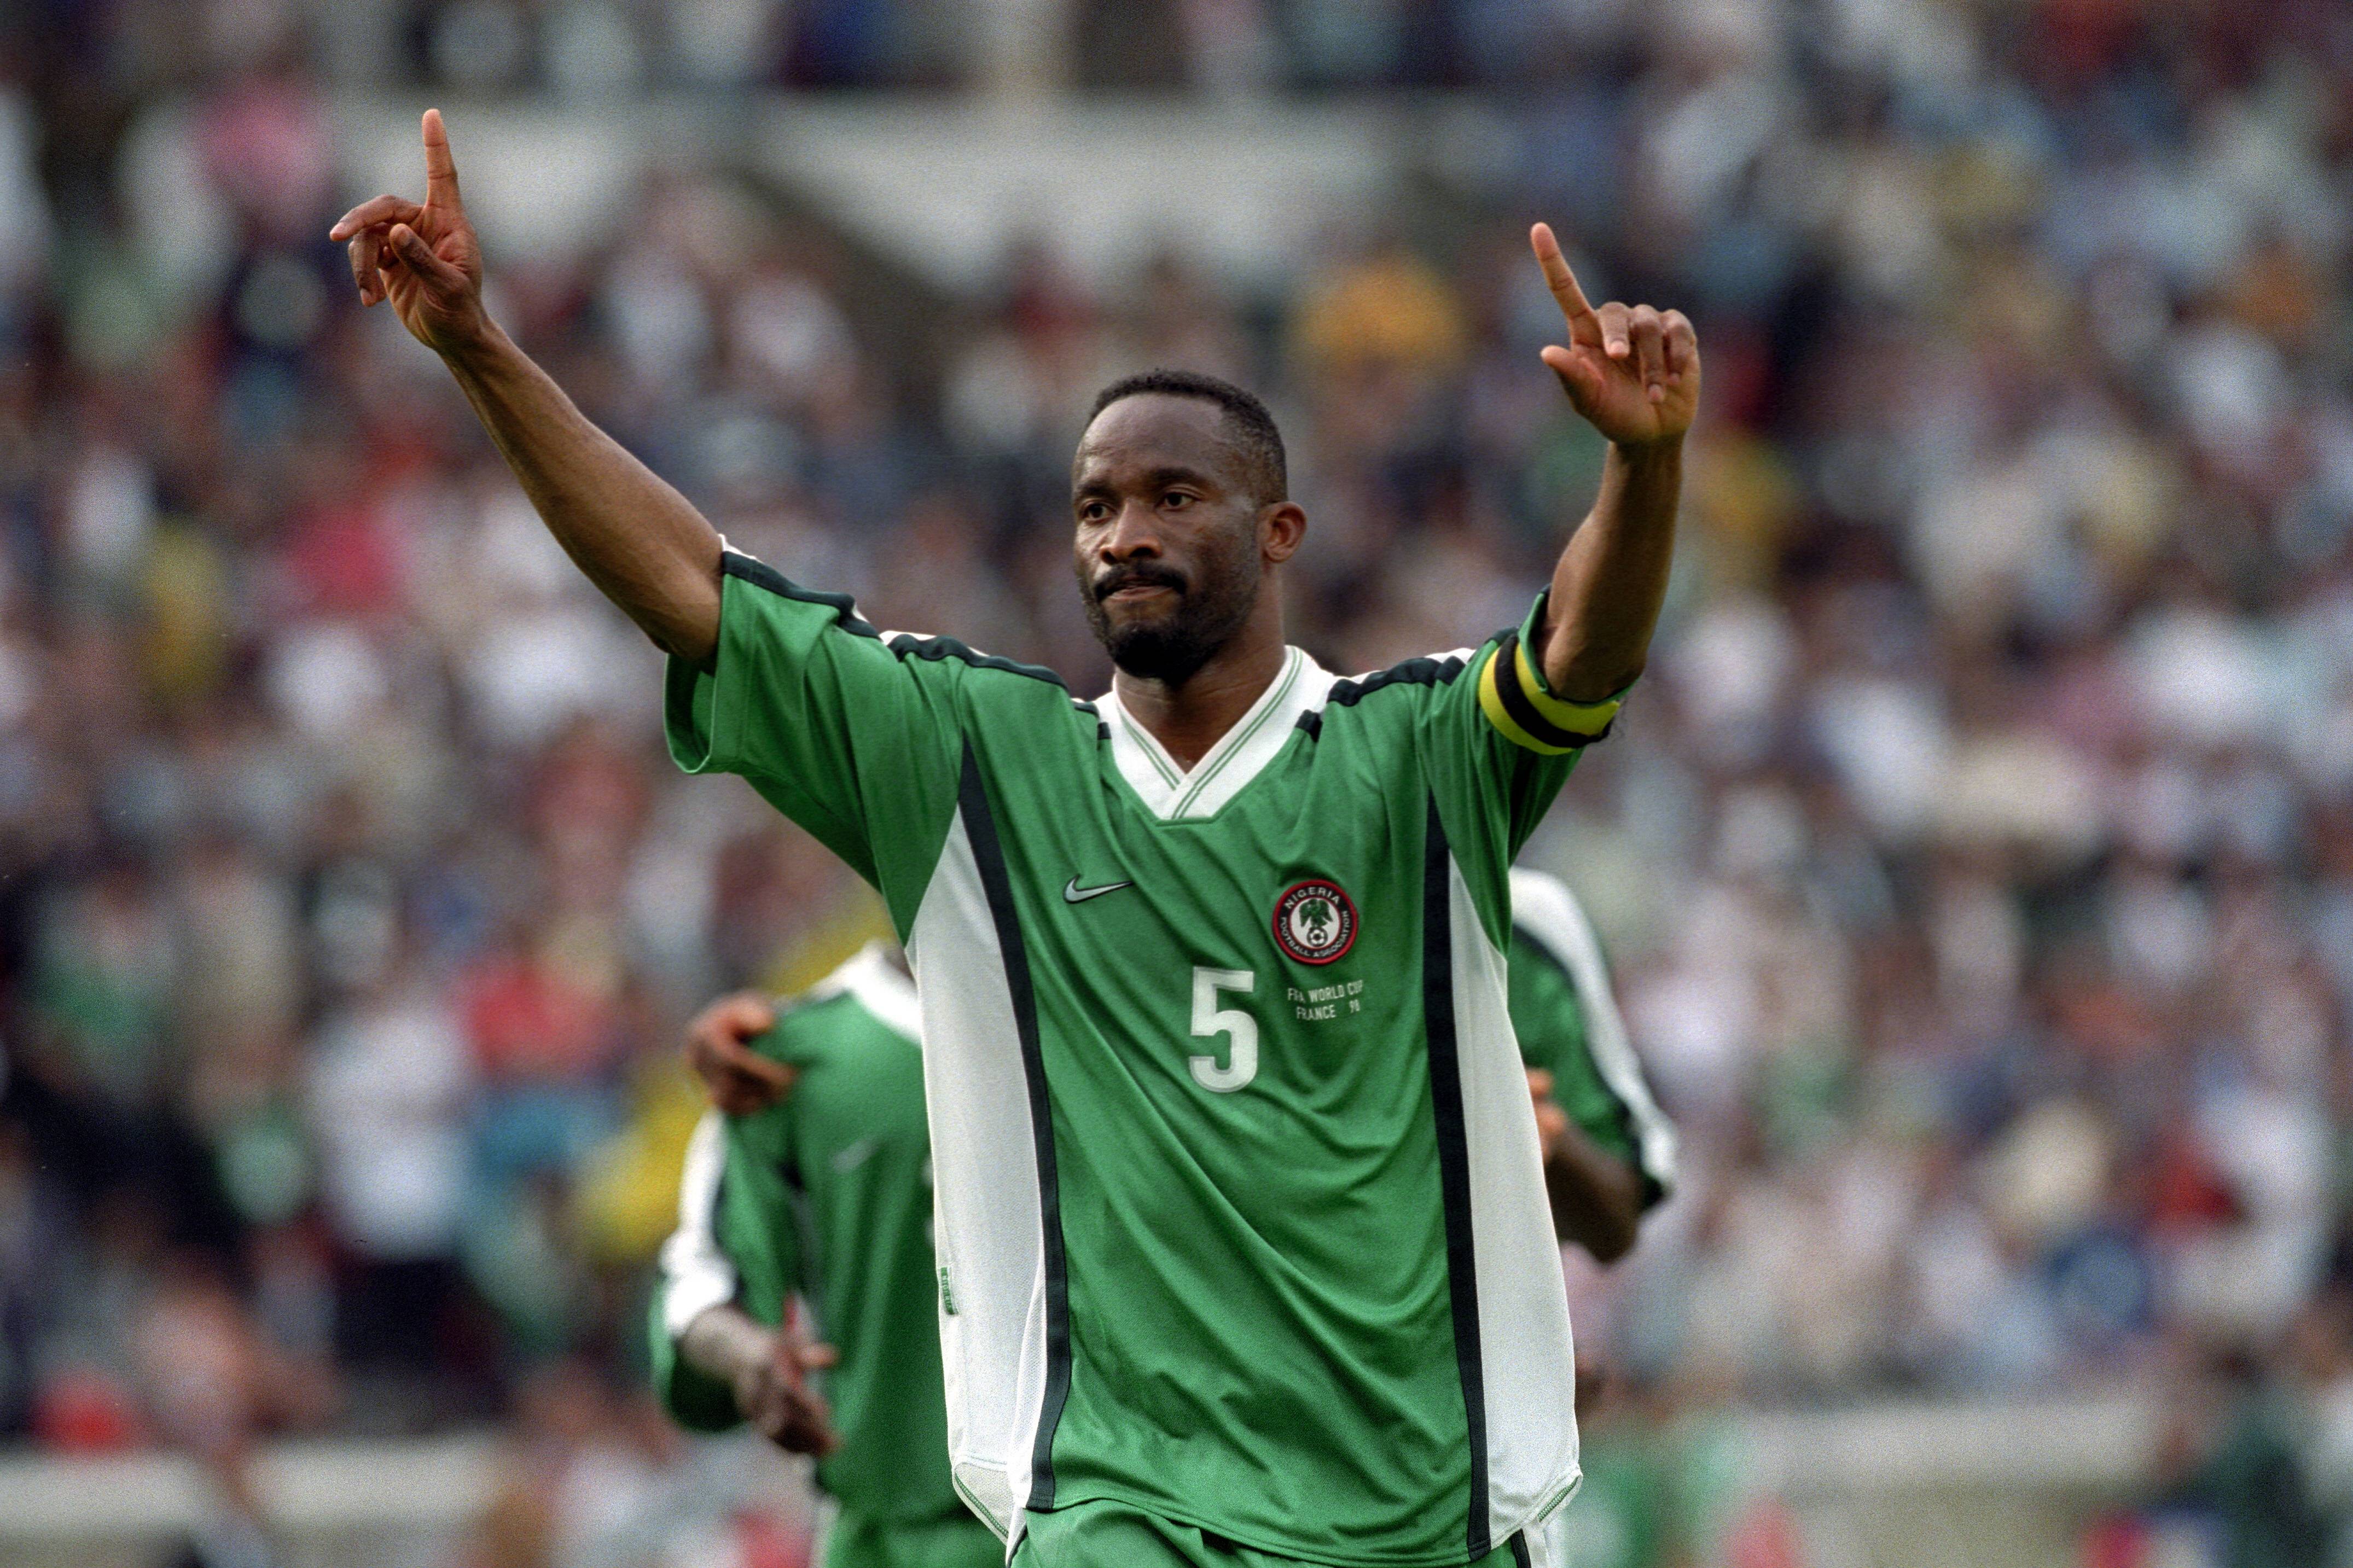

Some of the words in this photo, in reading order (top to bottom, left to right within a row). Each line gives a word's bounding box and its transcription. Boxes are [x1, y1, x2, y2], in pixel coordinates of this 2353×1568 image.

[1285, 887, 1340, 909] NIGERIA
[1280, 917, 1310, 956] FOOTBALL
[1308, 985, 1345, 1003] WORLD
[1297, 1004, 1337, 1021] FRANCE
[1189, 966, 1258, 1093] 5
